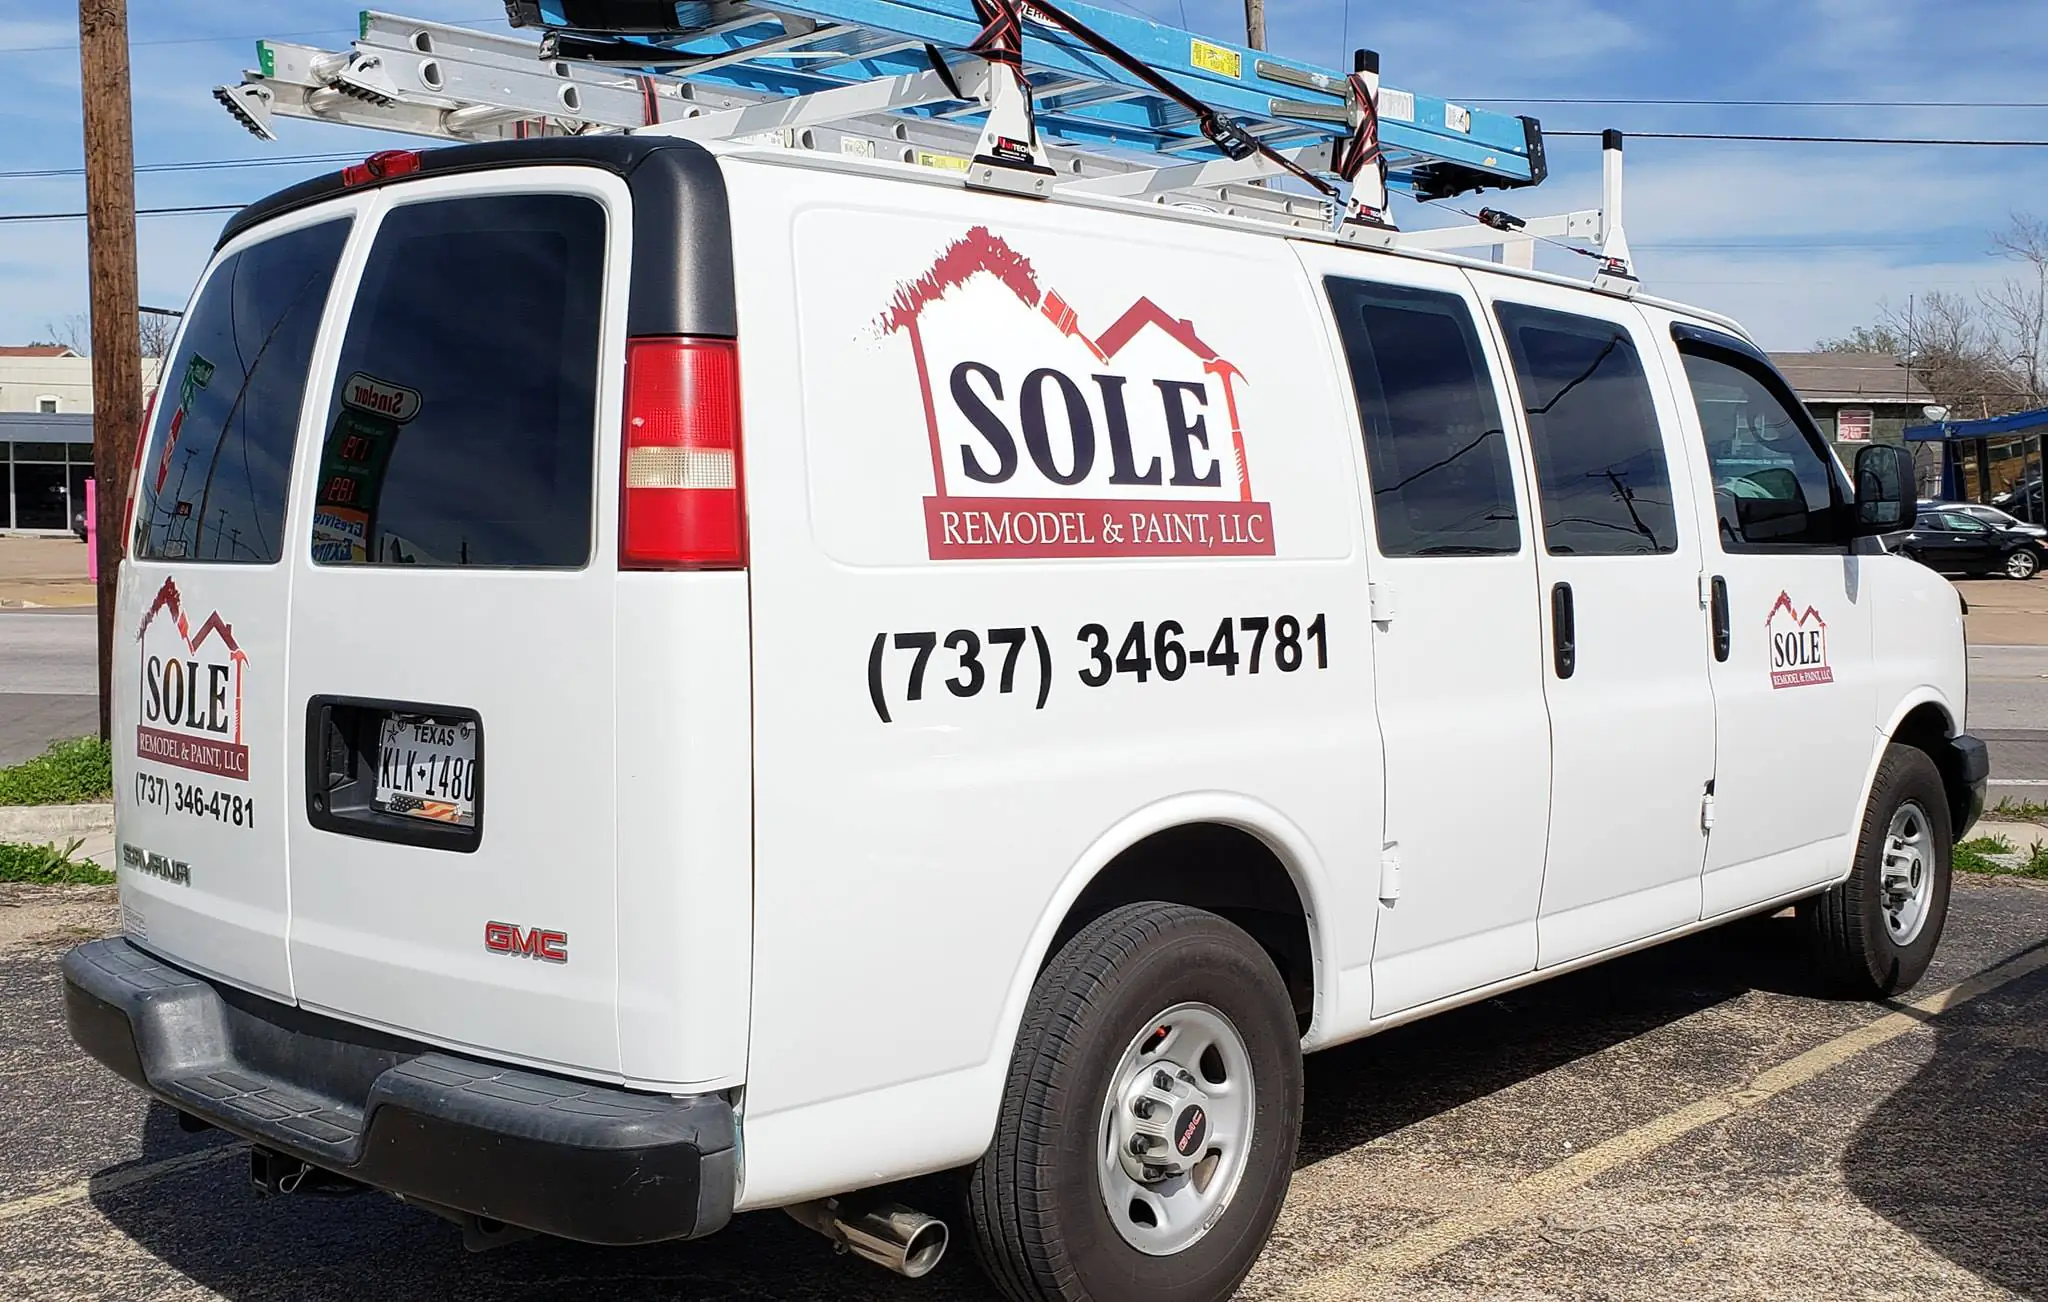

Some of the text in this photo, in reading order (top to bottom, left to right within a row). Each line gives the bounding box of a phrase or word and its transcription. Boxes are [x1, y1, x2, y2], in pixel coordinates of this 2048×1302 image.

[950, 361, 1222, 488] SOLE
[940, 511, 1264, 548] REMODEL & PAINT, LLC
[868, 613, 1328, 723] (737) 346-4781
[1774, 631, 1821, 668] SOLE
[146, 655, 229, 734] SOLE
[139, 732, 245, 772] REMODEL & PAINT, LLC
[413, 724, 455, 747] TEXAS
[136, 771, 253, 829] (737) 346-4781
[123, 842, 191, 888] SAVANA
[485, 920, 568, 965] GMC
[1178, 1109, 1203, 1152] GMC
